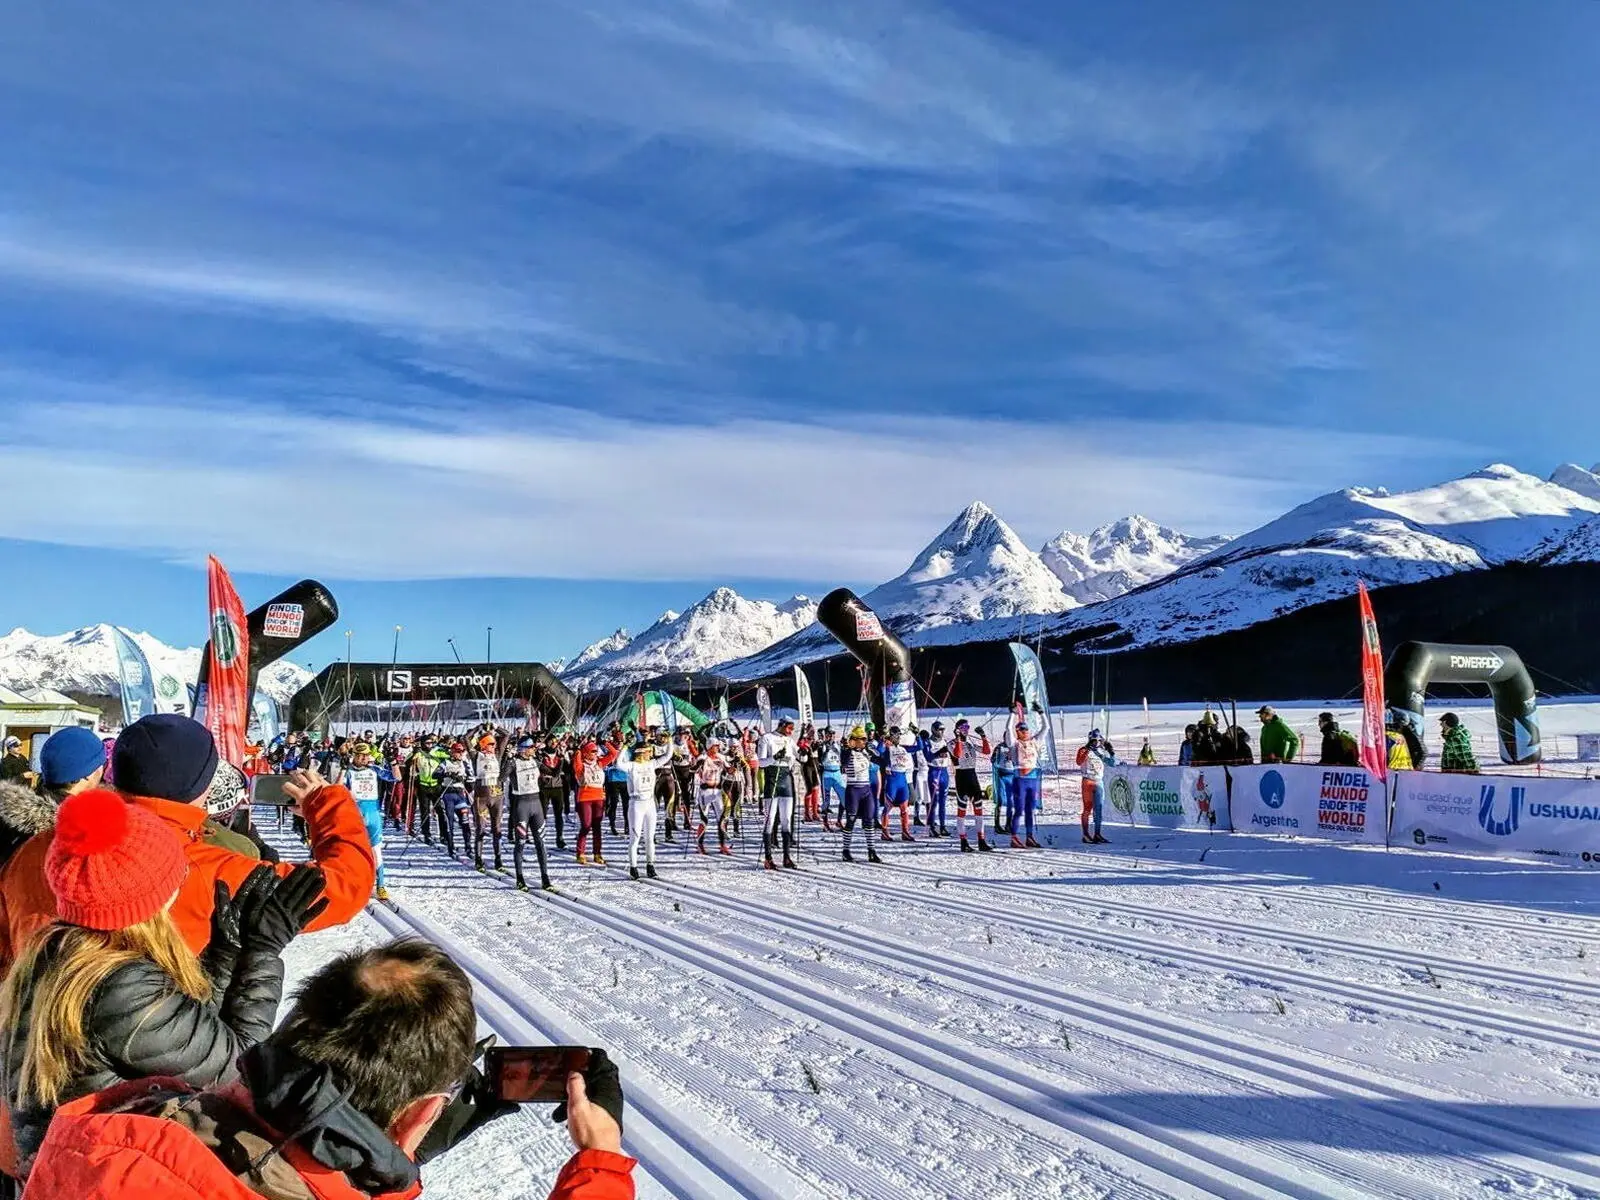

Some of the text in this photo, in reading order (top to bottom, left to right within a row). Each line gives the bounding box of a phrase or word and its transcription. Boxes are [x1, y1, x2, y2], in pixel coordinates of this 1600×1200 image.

[268, 612, 302, 621] MUNDO
[266, 624, 301, 634] WORLD
[1450, 655, 1502, 669] POWERADE
[1139, 780, 1166, 791] CLUB
[1138, 791, 1179, 804] ANDINO
[1320, 786, 1369, 802] MUNDO
[1139, 803, 1186, 816] USHUAIA
[1319, 799, 1367, 812] END OF THE
[1529, 803, 1600, 821] USHUAI
[1318, 809, 1366, 826] WORLD
